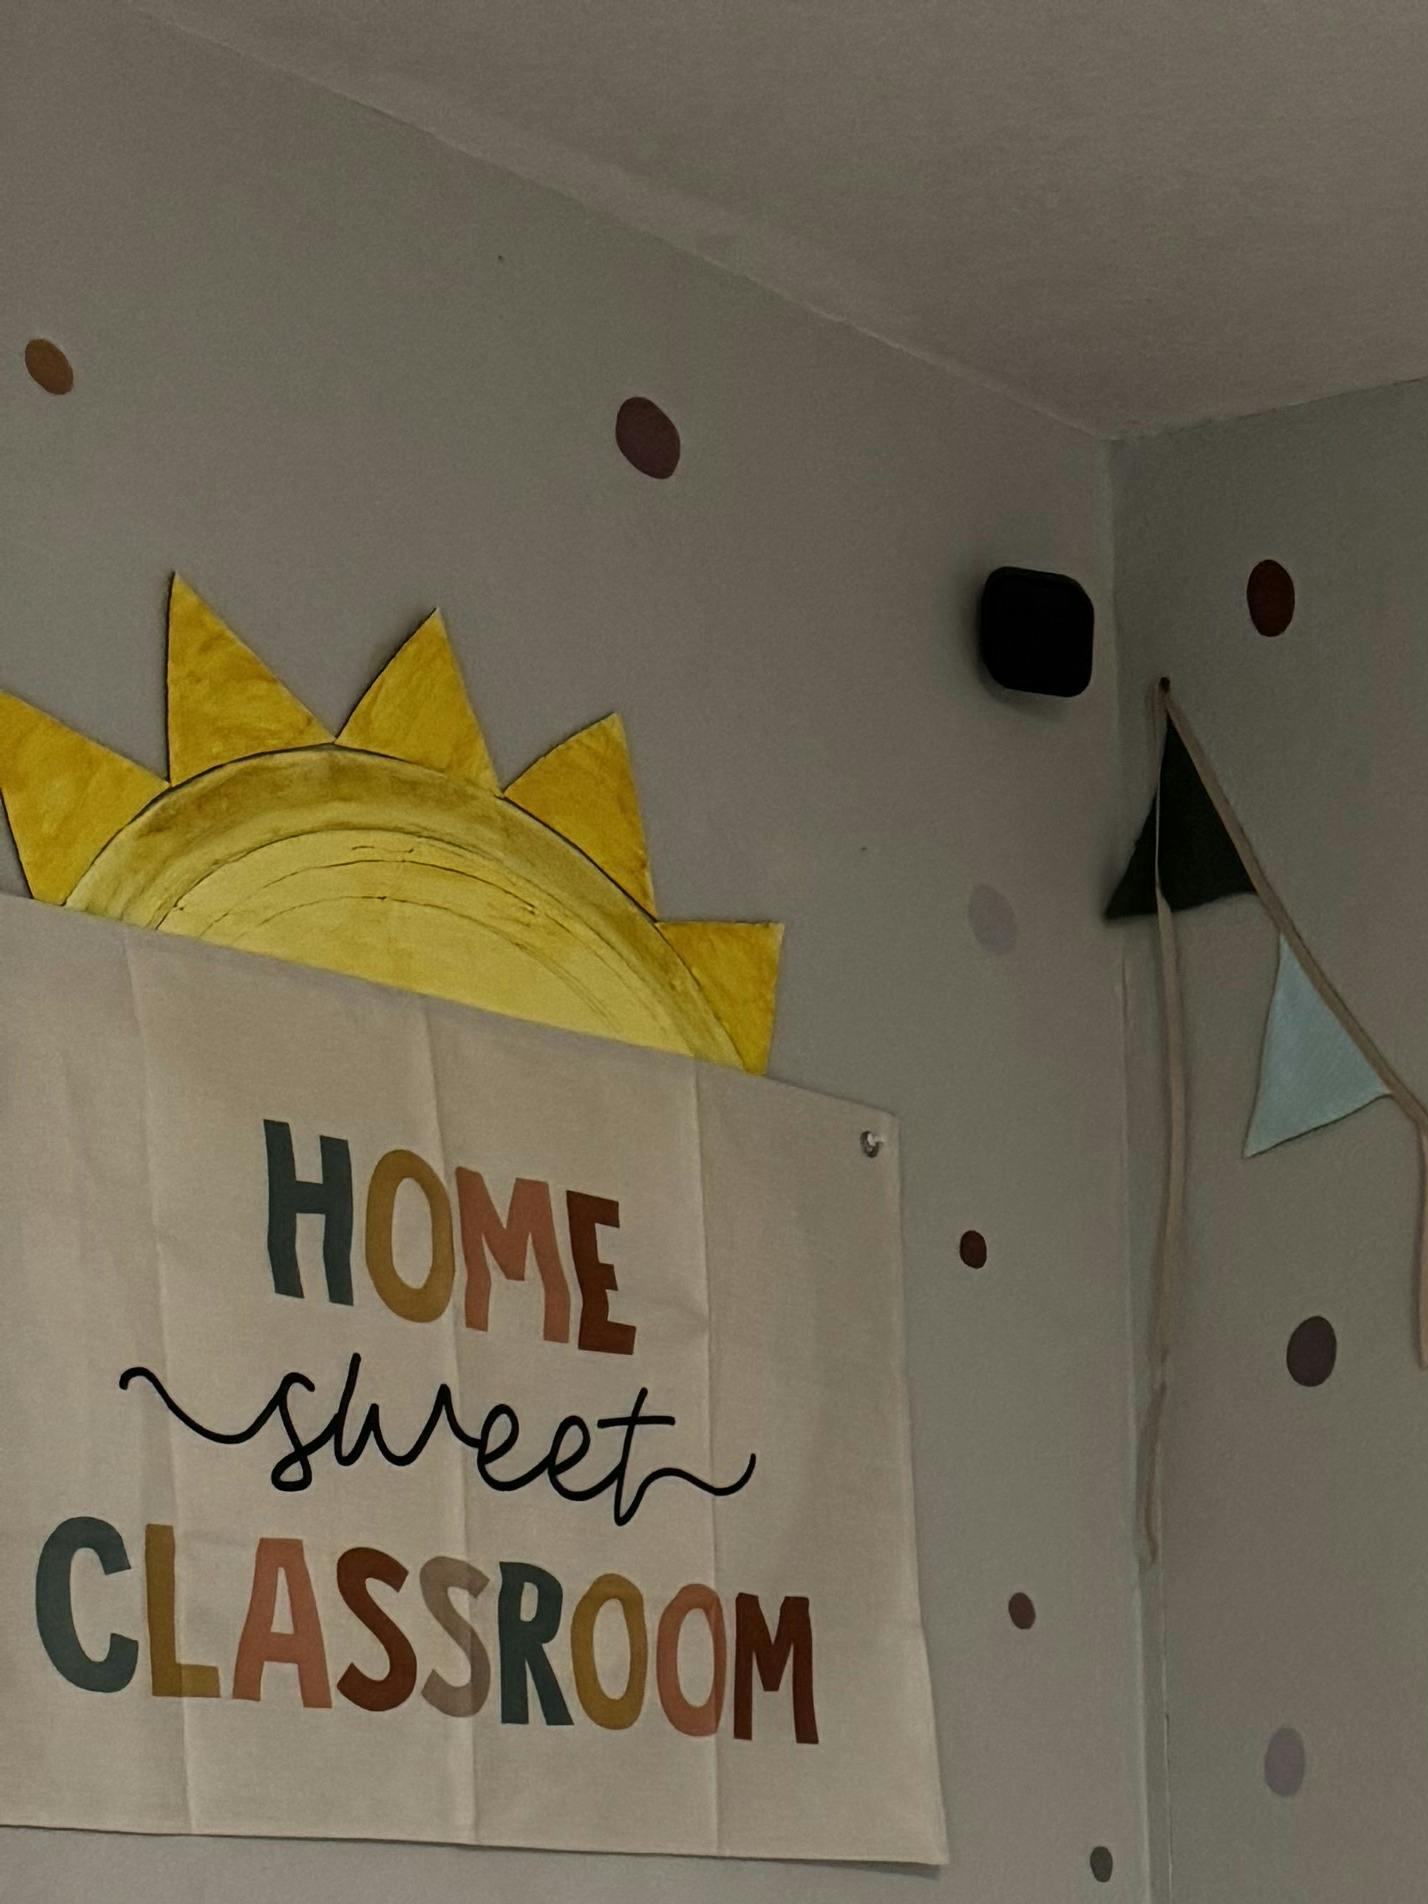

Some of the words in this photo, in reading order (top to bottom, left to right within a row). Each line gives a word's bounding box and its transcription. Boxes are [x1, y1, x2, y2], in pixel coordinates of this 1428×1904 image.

[263, 1119, 637, 1355] HOME
[119, 1353, 757, 1526] sweet
[35, 1516, 819, 1744] CLASSROOM
